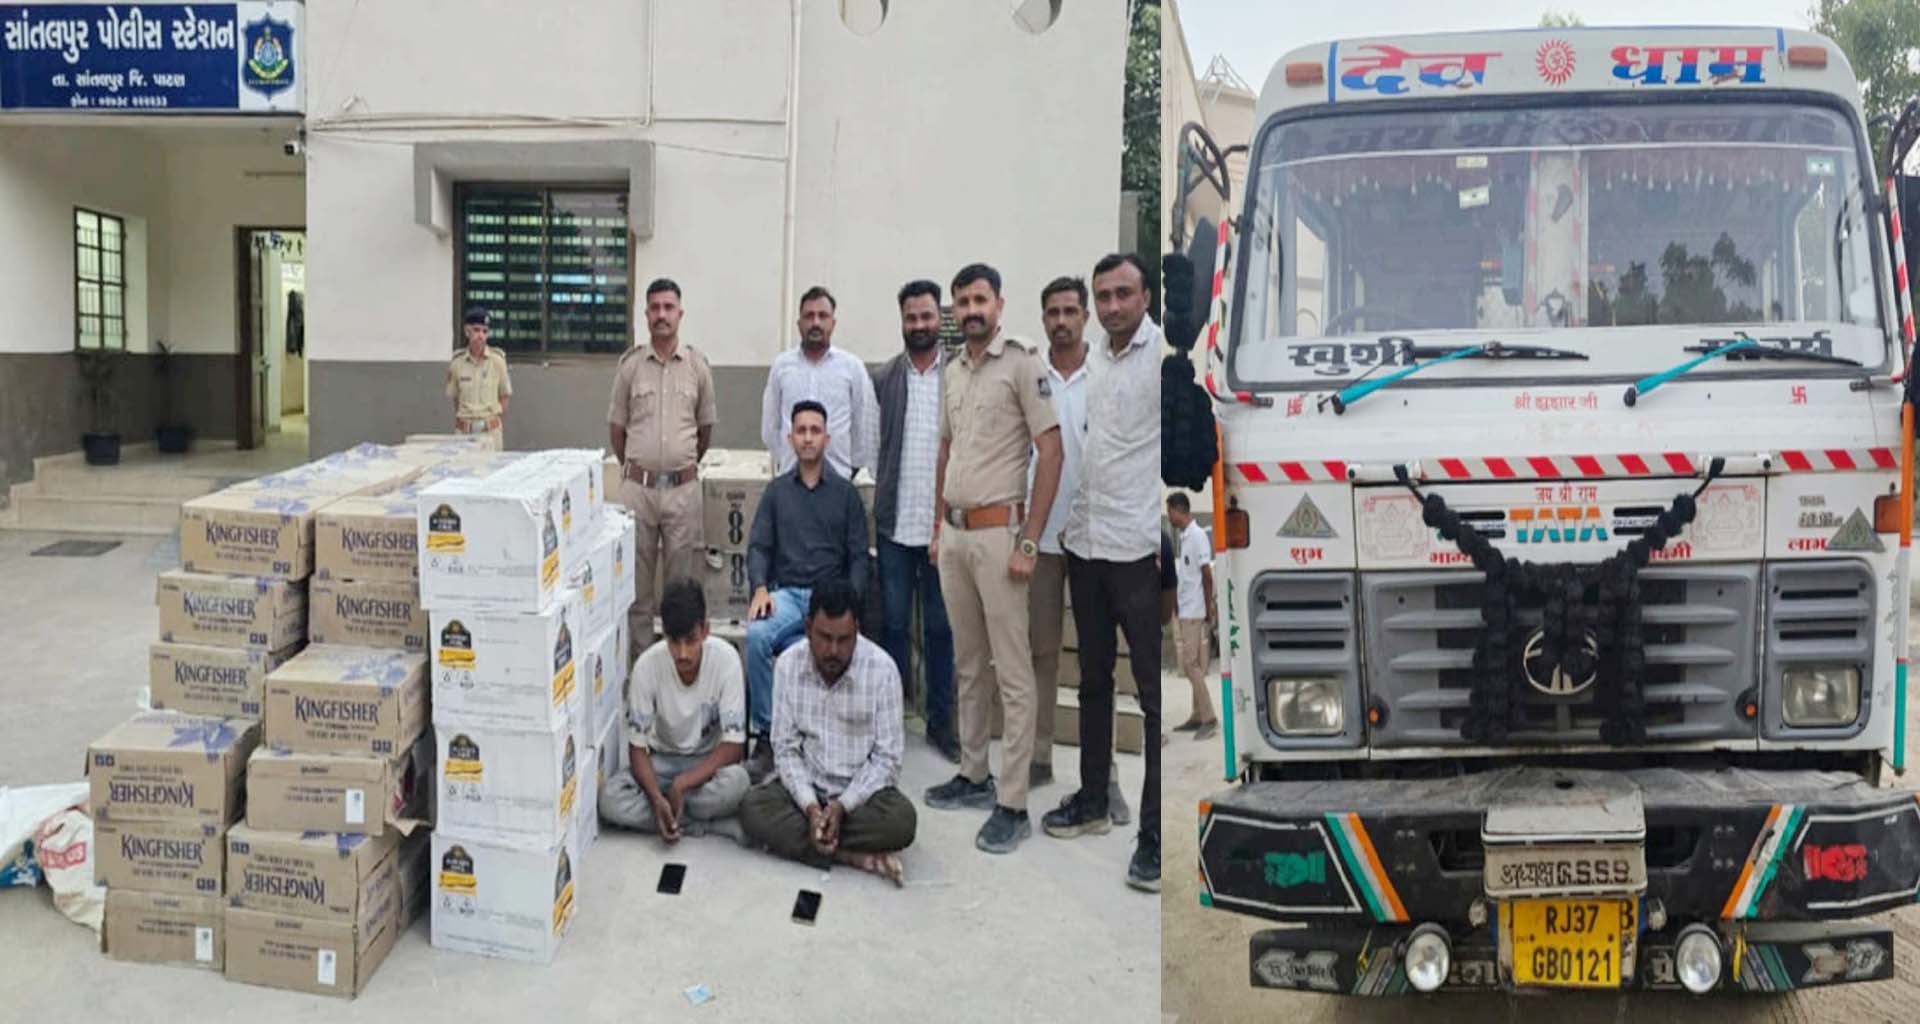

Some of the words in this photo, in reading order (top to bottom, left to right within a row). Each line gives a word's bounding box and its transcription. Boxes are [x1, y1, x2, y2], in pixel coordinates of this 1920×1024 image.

[4, 8, 90, 64] સાંતલપુર
[97, 6, 163, 50] પોલીસ
[171, 6, 235, 50] સ્ટેશન
[75, 69, 124, 93] સાંતલપુર
[1341, 44, 1503, 95] देव
[1610, 45, 1774, 85] धाम
[1534, 486, 1554, 503] जय
[1558, 480, 1573, 503] श्री
[1576, 485, 1598, 503] राम
[206, 520, 280, 549] KINGFISHER
[1509, 507, 1608, 543] TATA
[183, 593, 257, 620] KINGFISHER
[336, 594, 412, 621] KINGFISHER
[175, 661, 249, 687] KINGFISHER
[295, 695, 380, 726] KINGFISHER
[107, 781, 195, 808] KINGFISHER
[121, 834, 204, 864] KINGFISHER
[242, 869, 326, 905] KINGFISHER
[1545, 904, 1599, 935] RJ37
[1532, 946, 1612, 983] GB0121
